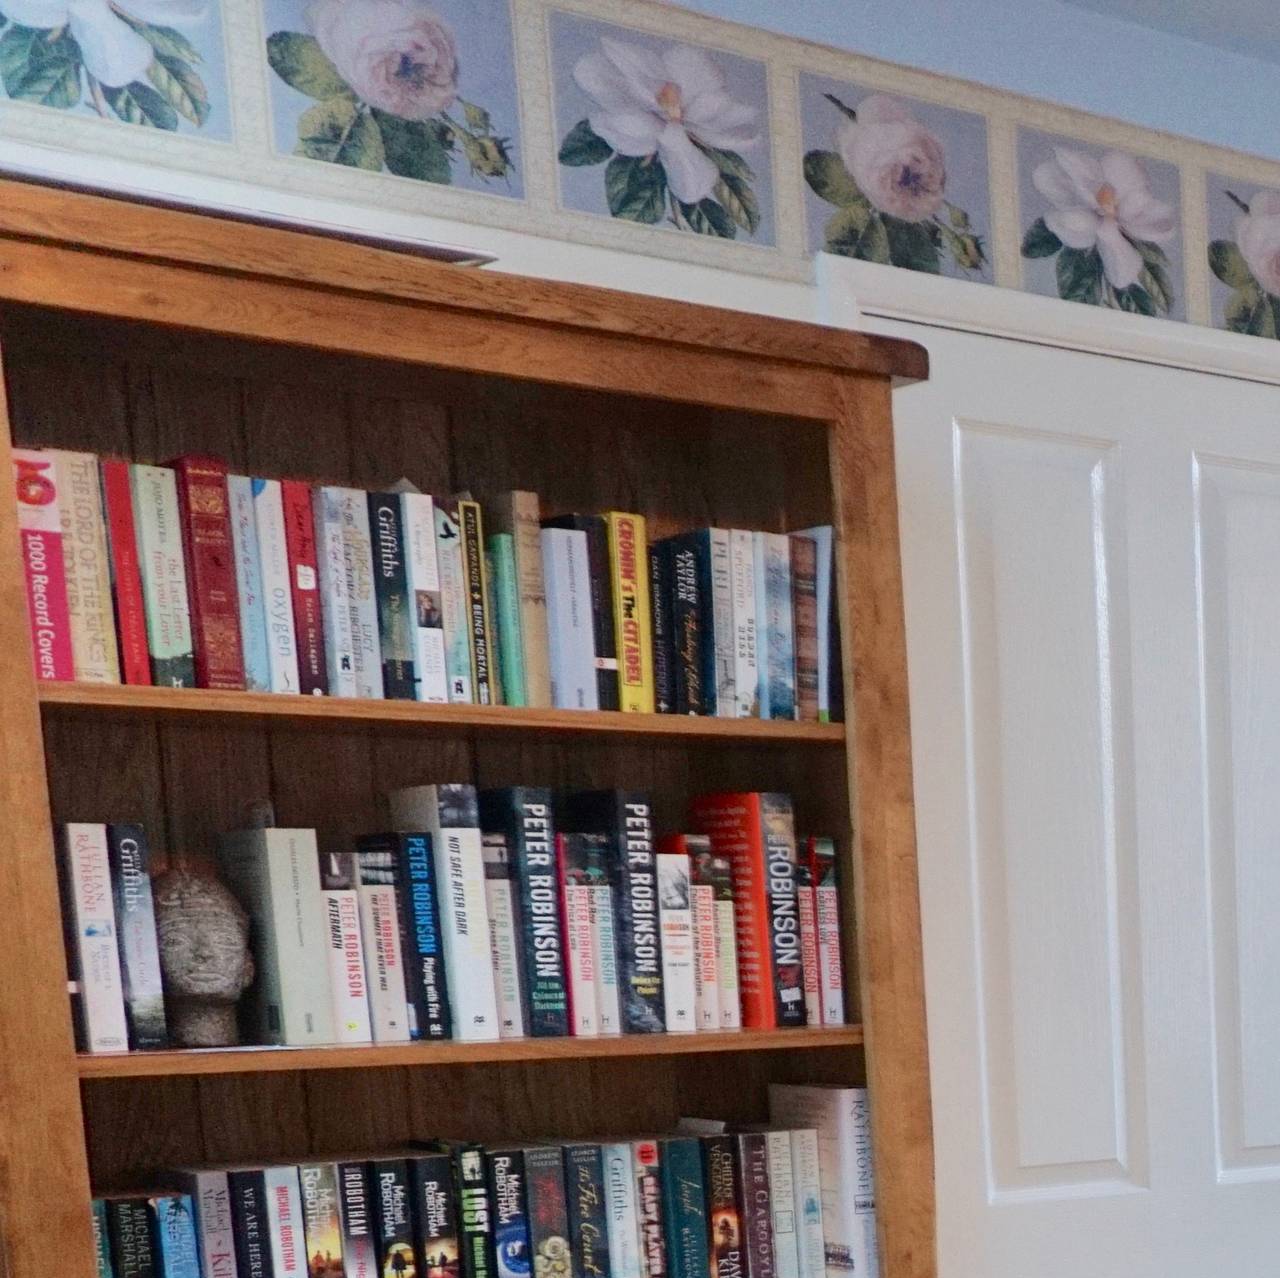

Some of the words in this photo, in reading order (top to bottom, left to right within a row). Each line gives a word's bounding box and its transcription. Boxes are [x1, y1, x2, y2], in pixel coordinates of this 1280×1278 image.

[70, 461, 91, 495] THE
[76, 497, 96, 545] LORD
[377, 505, 399, 577] Griffiths
[27, 533, 45, 570] 1000
[78, 546, 98, 571] OF
[82, 575, 101, 610] THE
[676, 552, 688, 601] TAYLOR
[684, 549, 697, 605] ANDREW
[33, 574, 53, 627] Record
[270, 587, 293, 657] oxygen
[473, 603, 485, 636] BEING
[38, 629, 57, 679] Covers
[361, 623, 374, 653] LUCY
[476, 638, 489, 679] MORTAL
[655, 639, 669, 702] HYPERION
[448, 835, 461, 854] NOT
[522, 803, 551, 865] PETER
[624, 803, 650, 863] PETER
[76, 833, 97, 913] RATHBONE
[90, 843, 106, 902] JULIAN
[119, 838, 141, 912] Griffiths
[407, 837, 429, 880] PETER
[449, 856, 463, 879] SAFE
[340, 896, 357, 929] PETER
[380, 893, 391, 917] PETER
[452, 880, 466, 908] AFTER
[495, 888, 508, 929] PETER
[575, 888, 590, 922] PETER
[597, 888, 610, 923] PETER
[698, 888, 712, 922] PETER
[768, 847, 798, 964] ROBINSON
[800, 888, 814, 927] PETER
[825, 889, 838, 927] PETER
[328, 896, 341, 950] AFTERMATH
[372, 907, 382, 936] SUMMER
[414, 882, 438, 954] ROBINSON
[455, 910, 469, 936] DARK
[529, 874, 560, 977] ROBINSON
[630, 872, 659, 972] ROBINSON
[345, 933, 363, 998] ROBINSON
[374, 938, 384, 954] THAT
[382, 919, 396, 967] ROBINSON
[578, 924, 593, 982] ROBINSON
[599, 925, 615, 985] ROBINSON
[700, 924, 715, 982] ROBINSON
[802, 931, 817, 993] ROBINSON
[827, 930, 841, 990] ROBINSON
[422, 957, 436, 984] Playing
[498, 934, 515, 1002] ROBINSON
[427, 985, 438, 1002] with
[428, 1003, 440, 1018] Fire
[719, 1152, 733, 1183] CHILD
[751, 1144, 766, 1185] THE
[851, 1100, 870, 1192] RATHBONE
[202, 1188, 217, 1234] Marshall
[215, 1189, 230, 1231] Michael
[242, 1186, 256, 1210] WE
[275, 1185, 291, 1222] MICHAEL
[344, 1173, 367, 1235] ROBOTHAM
[379, 1172, 395, 1237] ROBOTHAM
[392, 1184, 406, 1225] Michael
[424, 1180, 440, 1237] ROBOTHAM
[436, 1191, 449, 1226] Michael
[462, 1188, 490, 1233] LOST
[493, 1156, 512, 1224] ROBOTHAM
[506, 1173, 522, 1214] Michael
[577, 1182, 598, 1218] Fire
[608, 1156, 627, 1222] Griffiths
[642, 1176, 658, 1221] READY
[133, 1208, 153, 1272] MICHAEL
[165, 1199, 183, 1276] MARSHALL
[246, 1213, 260, 1240] ARE
[279, 1225, 297, 1272] ROBOTHAM
[249, 1242, 263, 1278] HERE
[580, 1222, 603, 1278] Court
[647, 1224, 663, 1275] PLAYER
